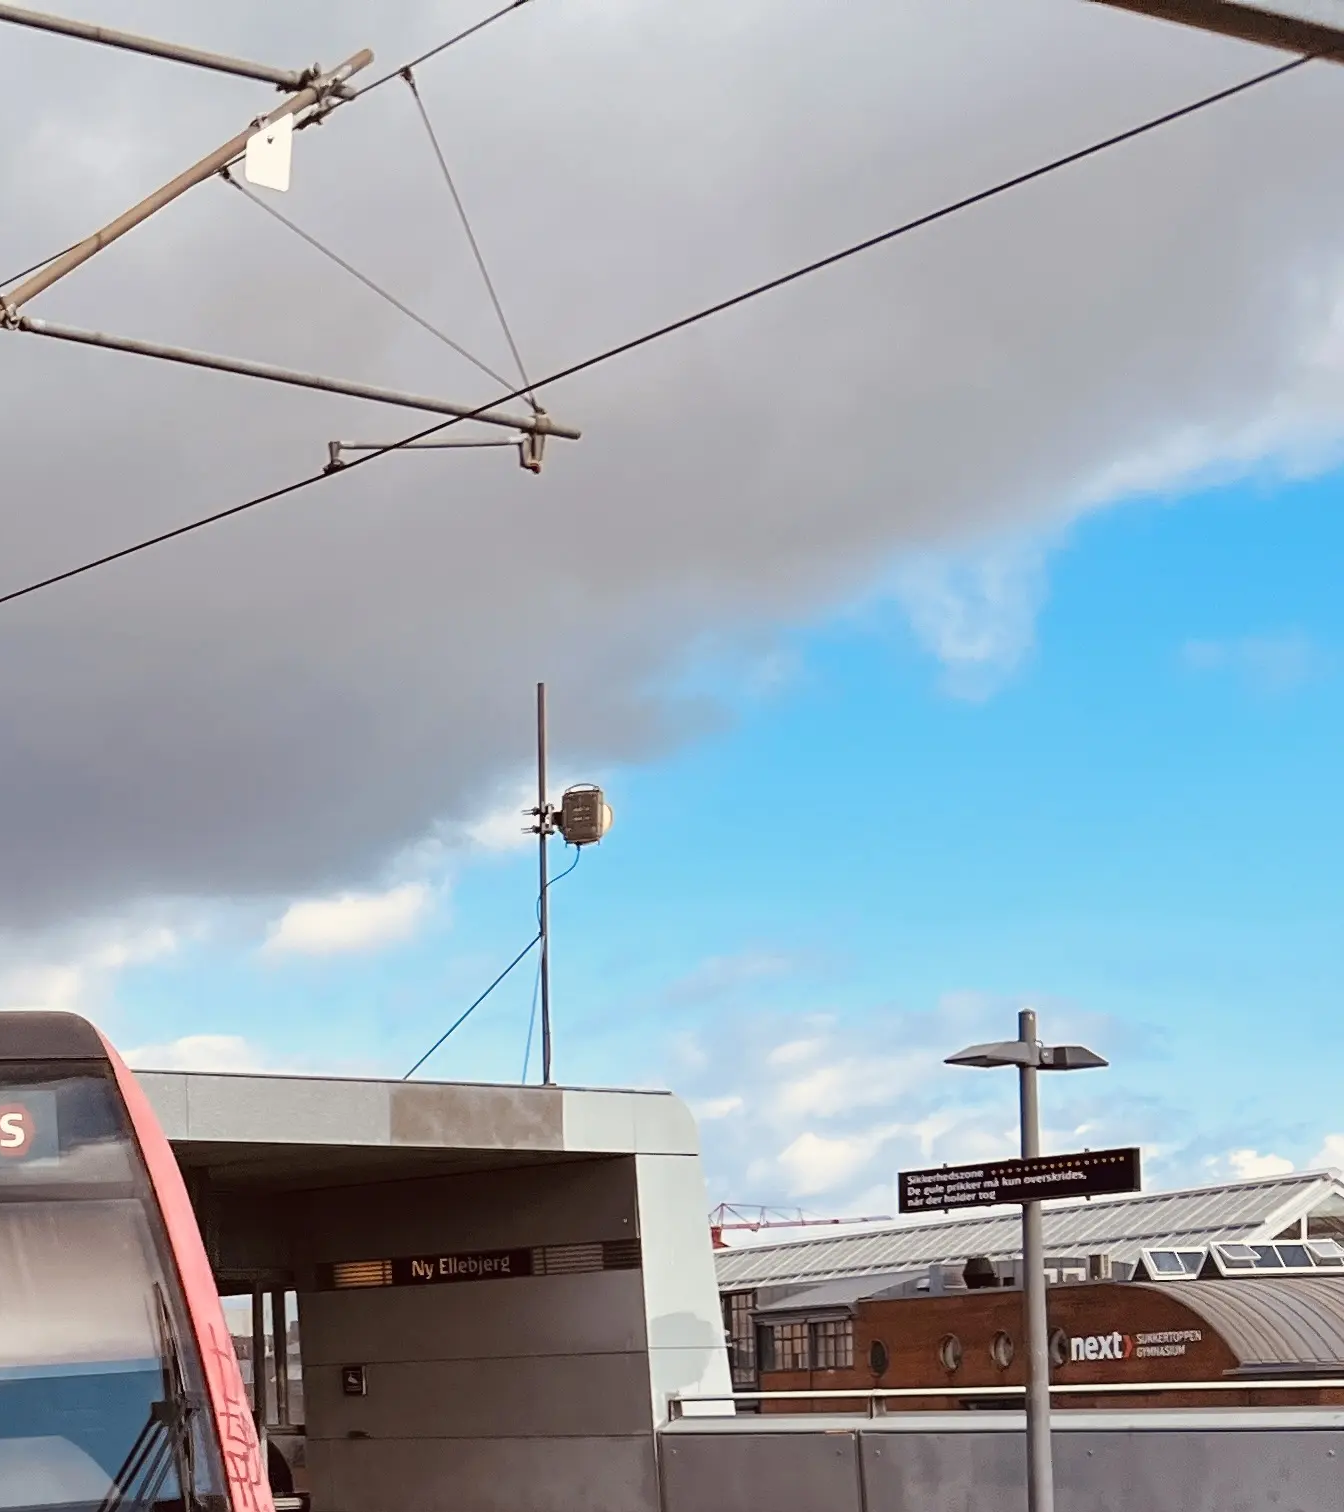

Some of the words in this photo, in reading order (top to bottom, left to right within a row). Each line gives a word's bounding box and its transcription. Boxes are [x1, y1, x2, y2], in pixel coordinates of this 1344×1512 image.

[0, 1112, 25, 1148] S
[907, 1170, 984, 1185] Sikkerhedszone
[907, 1186, 921, 1196] De
[924, 1184, 944, 1195] gule
[946, 1180, 981, 1194] prikker
[983, 1177, 999, 1188] må
[1002, 1177, 1021, 1187] kun
[907, 1197, 924, 1207] når
[925, 1195, 942, 1205] der
[944, 1192, 976, 1203] holder
[979, 1190, 996, 1200] tog
[412, 1260, 434, 1279] Ny
[439, 1256, 511, 1275] Ellebjerg
[1071, 1331, 1123, 1361] next
[1136, 1344, 1186, 1358] GYMNASIUM
